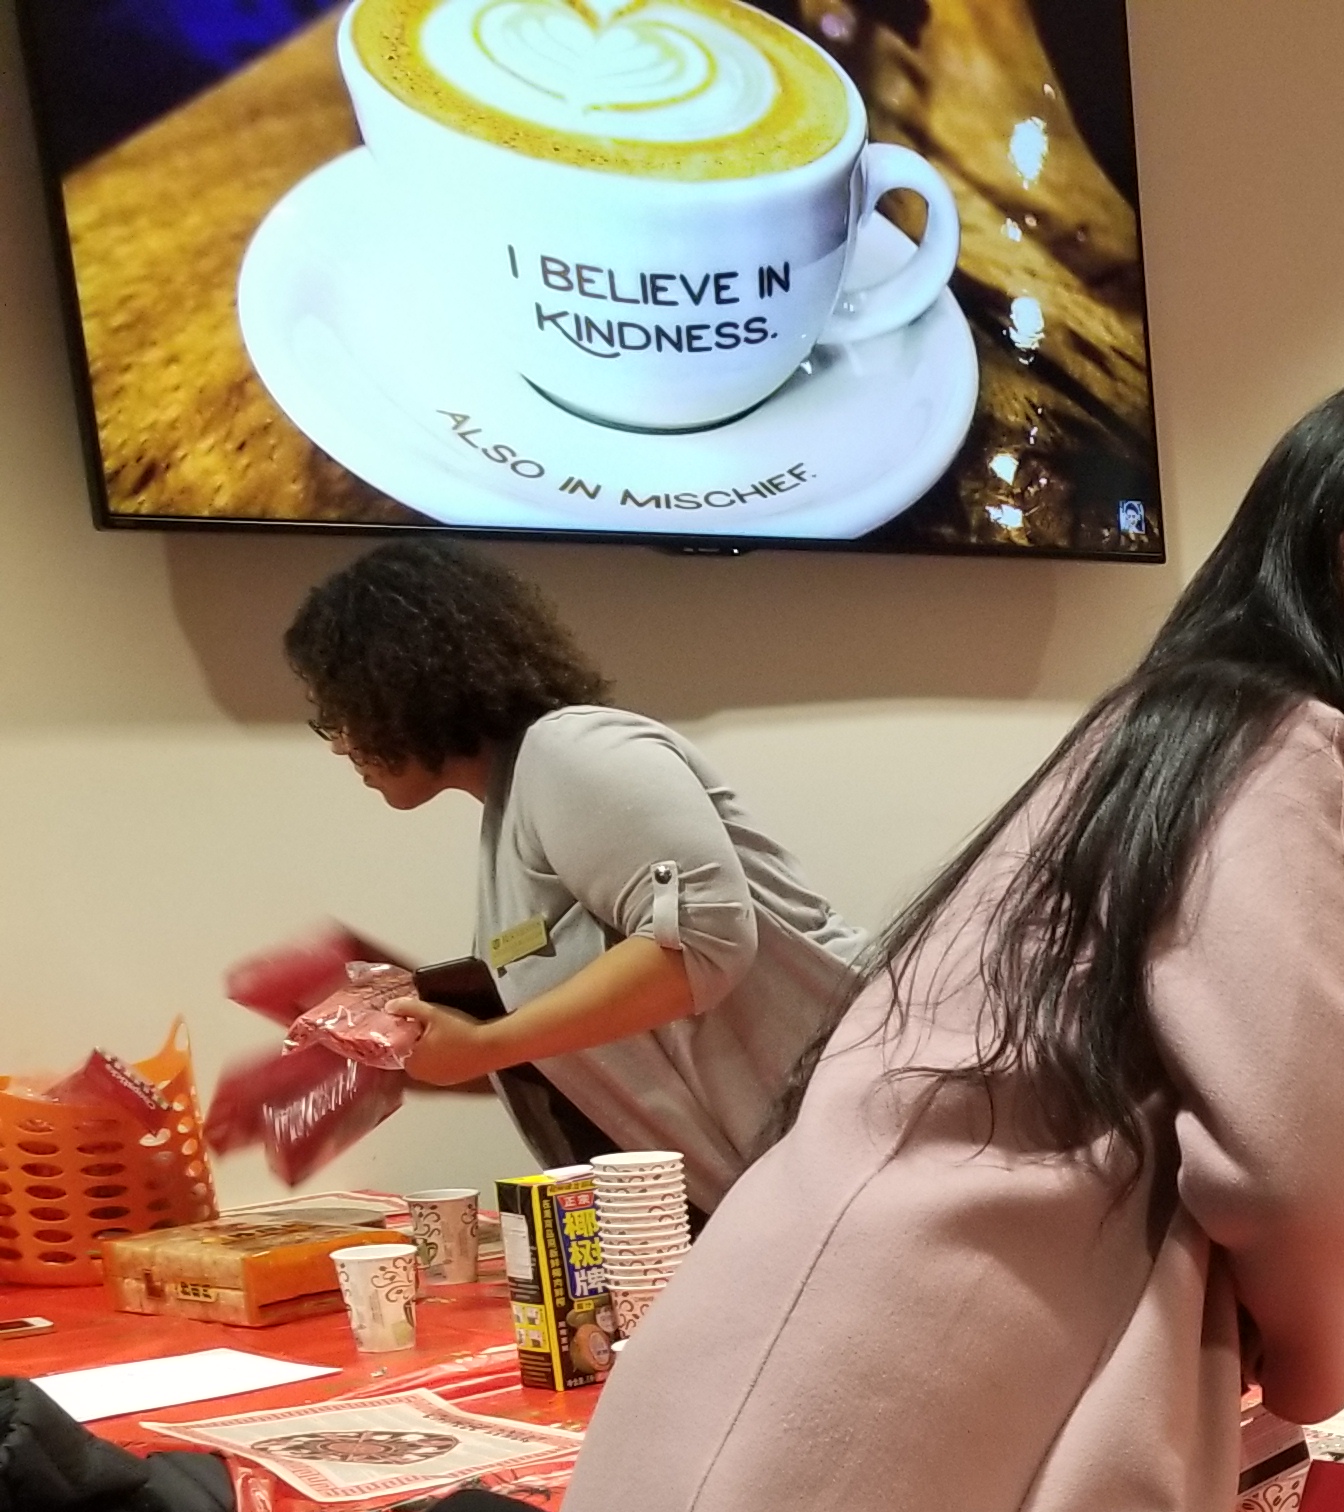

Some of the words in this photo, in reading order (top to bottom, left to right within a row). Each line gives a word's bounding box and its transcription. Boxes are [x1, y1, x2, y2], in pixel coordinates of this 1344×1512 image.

[507, 244, 519, 279] I
[540, 254, 740, 306] BELIEVE
[758, 261, 791, 300] IN
[534, 302, 778, 358] KINDNESS.
[436, 408, 546, 478] ALSO
[558, 476, 602, 500] IN
[619, 462, 818, 510] MISCHIEF.
